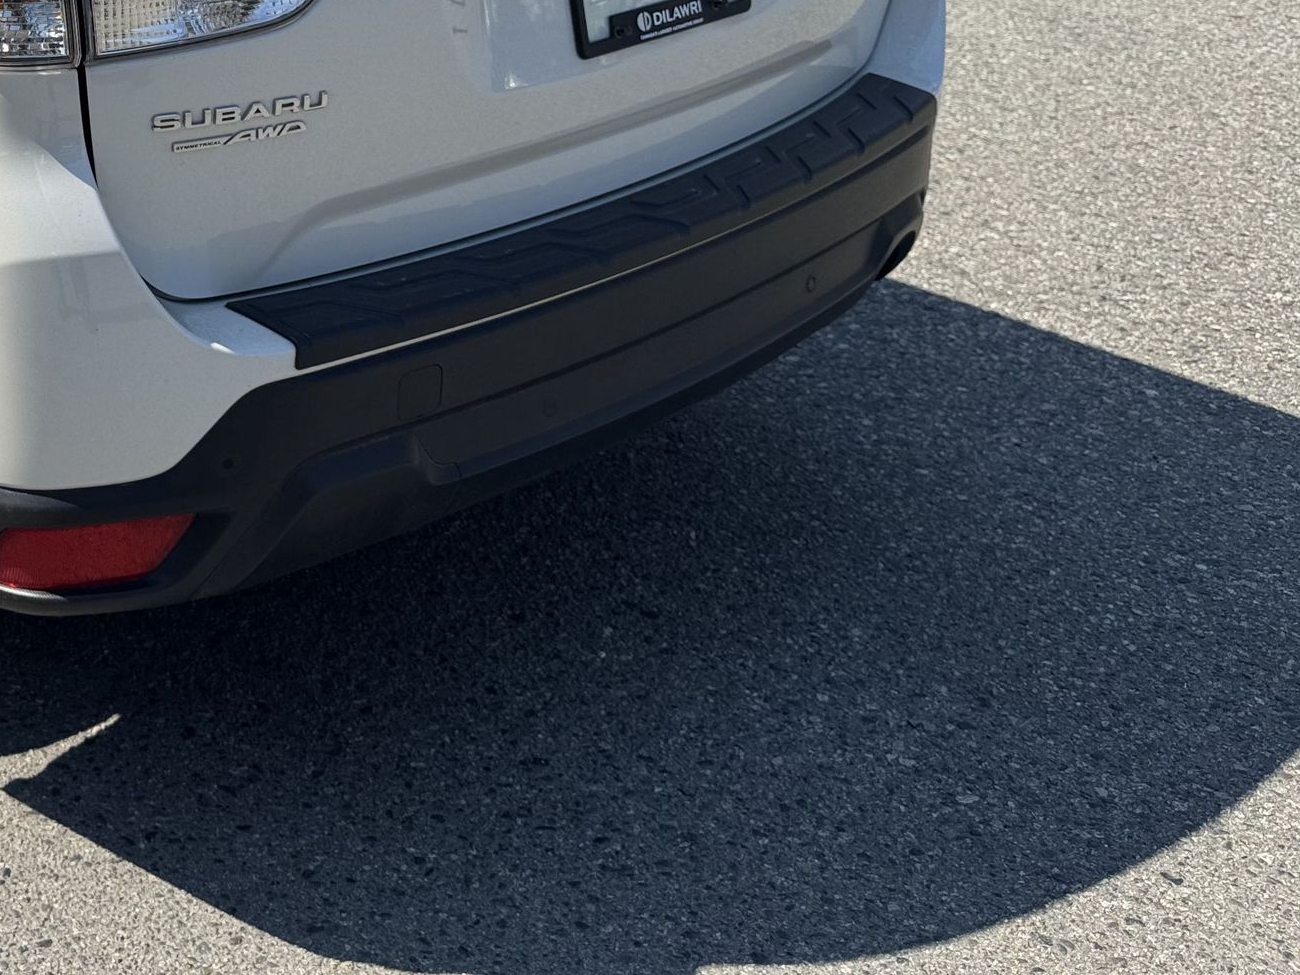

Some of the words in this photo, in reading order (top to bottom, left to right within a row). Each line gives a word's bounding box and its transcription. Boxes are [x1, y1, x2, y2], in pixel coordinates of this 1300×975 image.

[653, 0, 703, 26] DILAWRI
[151, 90, 329, 132] SUBARU
[175, 140, 222, 151] SYMMETRICAL
[226, 120, 307, 144] AWD
